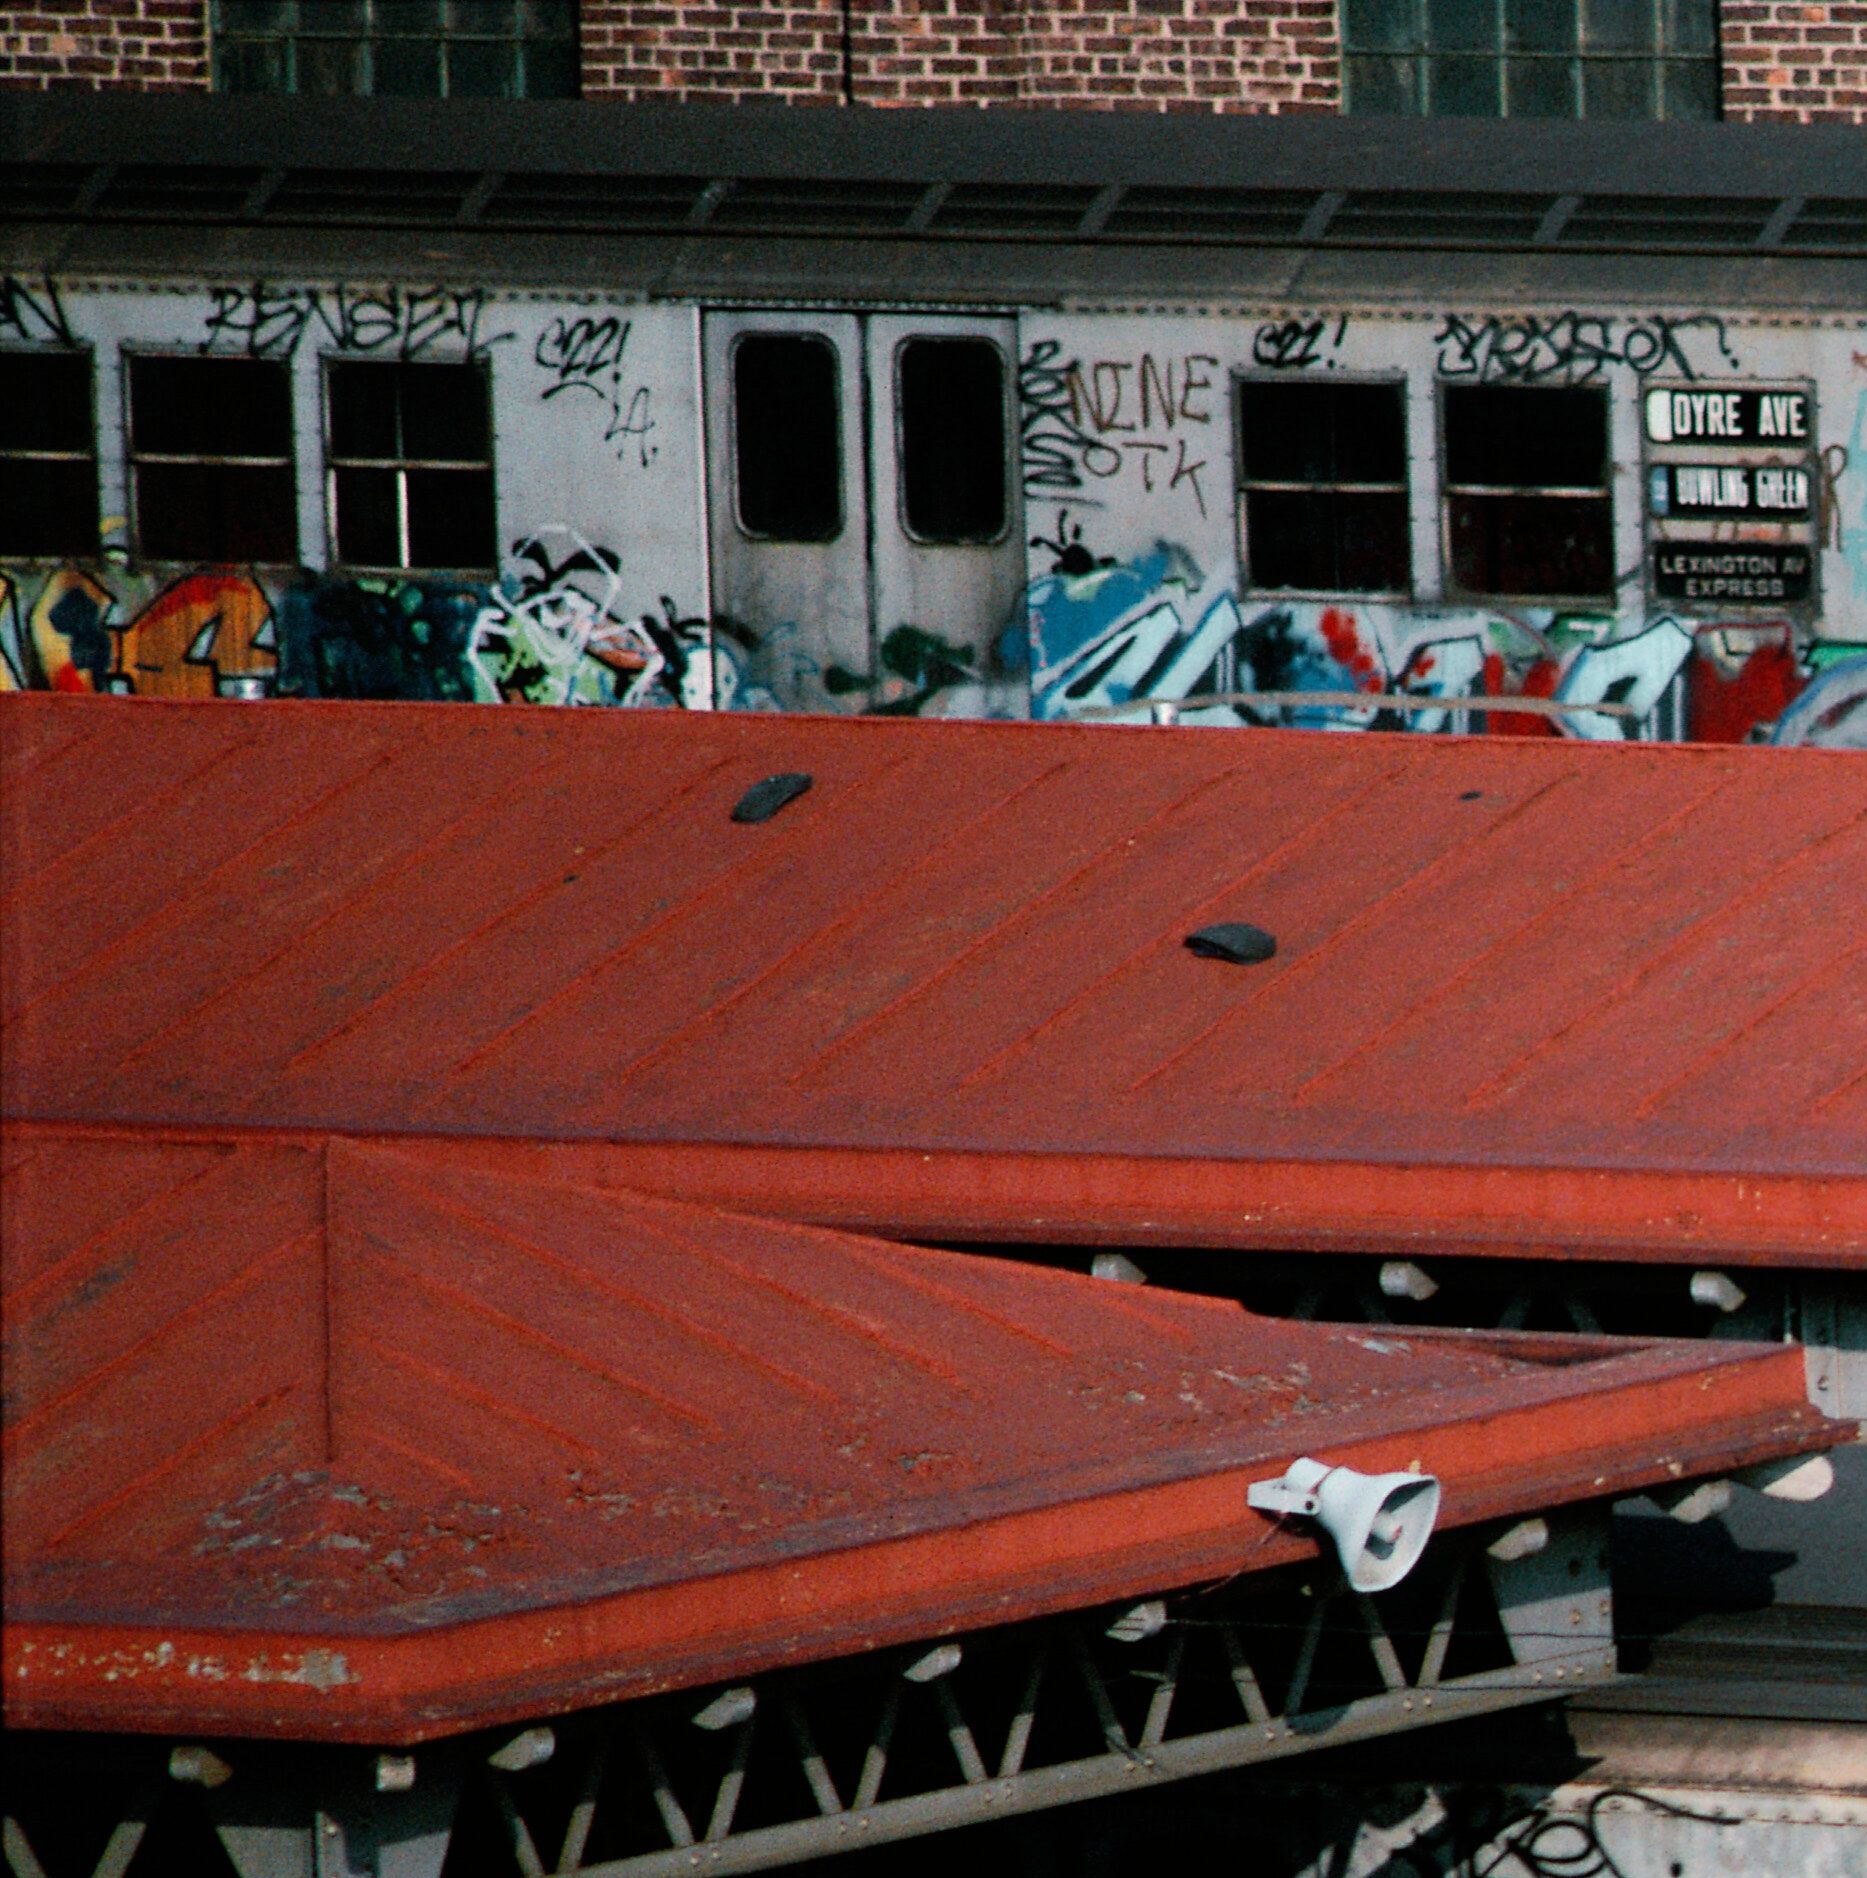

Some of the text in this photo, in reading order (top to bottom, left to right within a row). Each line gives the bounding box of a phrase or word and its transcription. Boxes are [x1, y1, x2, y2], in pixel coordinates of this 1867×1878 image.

[1673, 393, 1744, 436] DYRE
[1758, 396, 1807, 437] AVE
[1660, 555, 1777, 575] LEXINGTON
[1686, 578, 1784, 597] EXPRESS
